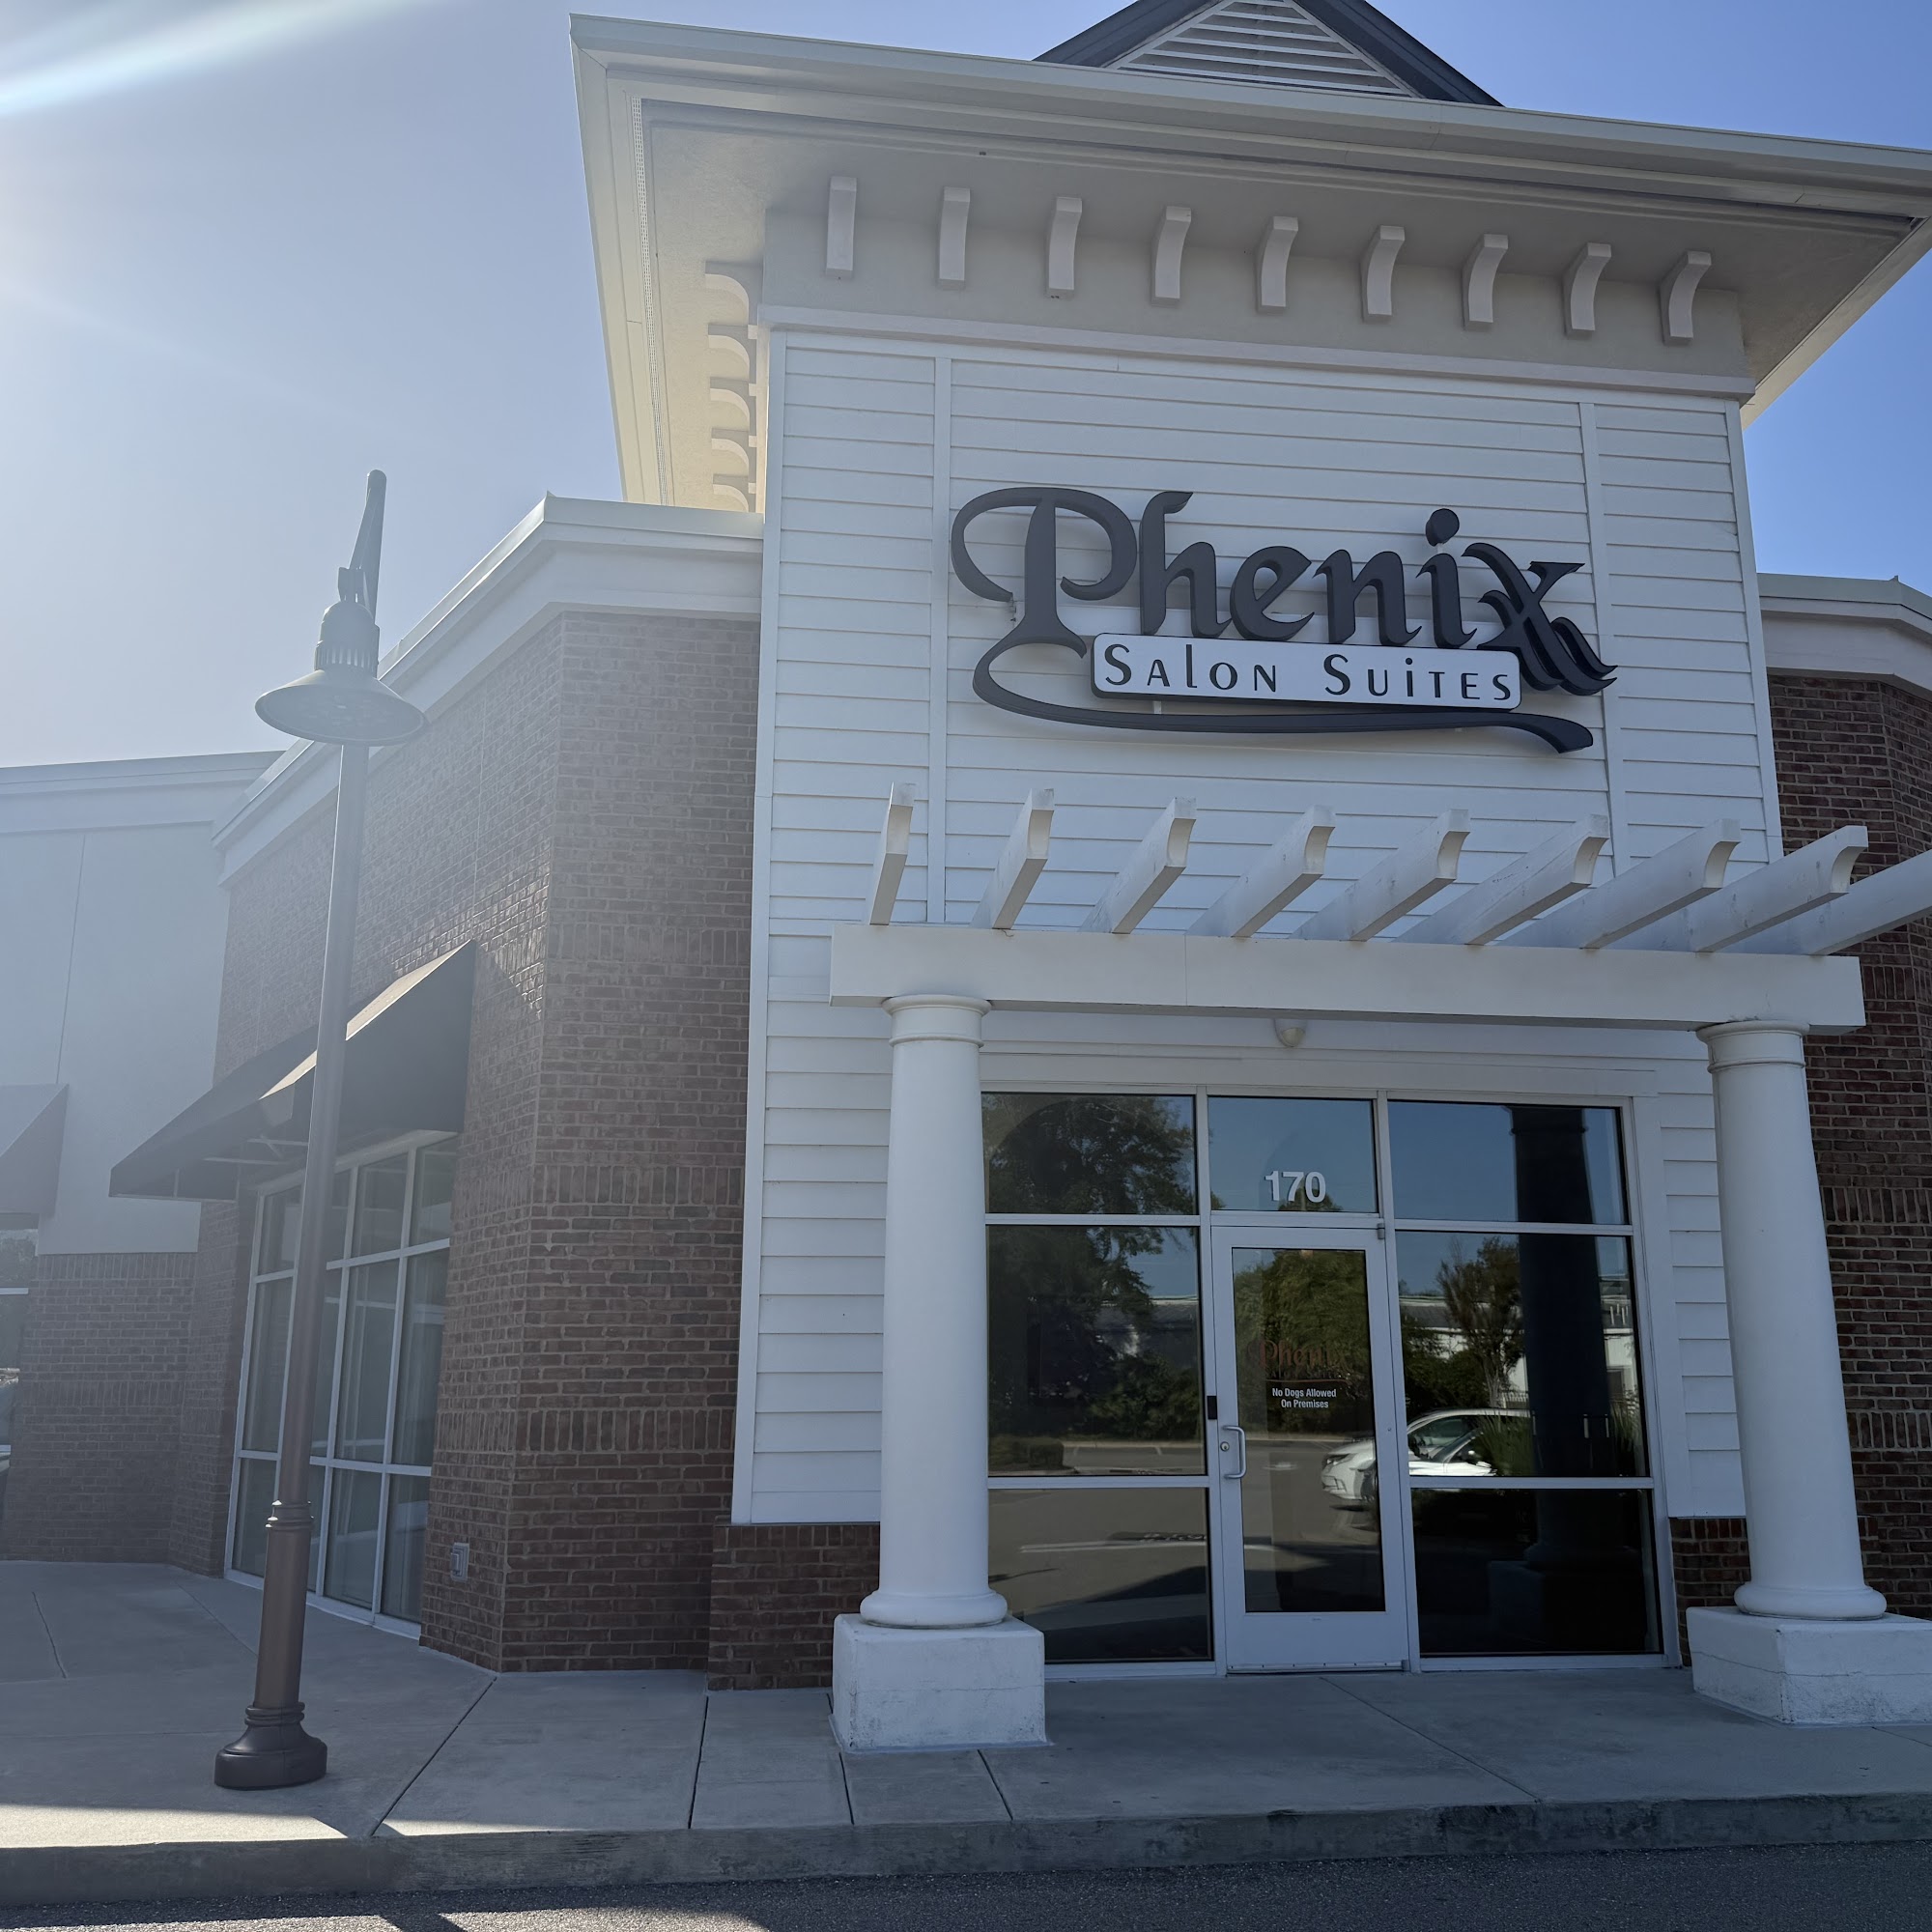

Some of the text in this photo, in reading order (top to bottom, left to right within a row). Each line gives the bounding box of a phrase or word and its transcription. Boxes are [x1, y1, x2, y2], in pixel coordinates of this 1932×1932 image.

[951, 487, 1617, 699] Phenix
[1264, 1170, 1326, 1203] 170
[1271, 1387, 1337, 1399] No Dogs Allowed
[1281, 1399, 1329, 1408] On Premises
